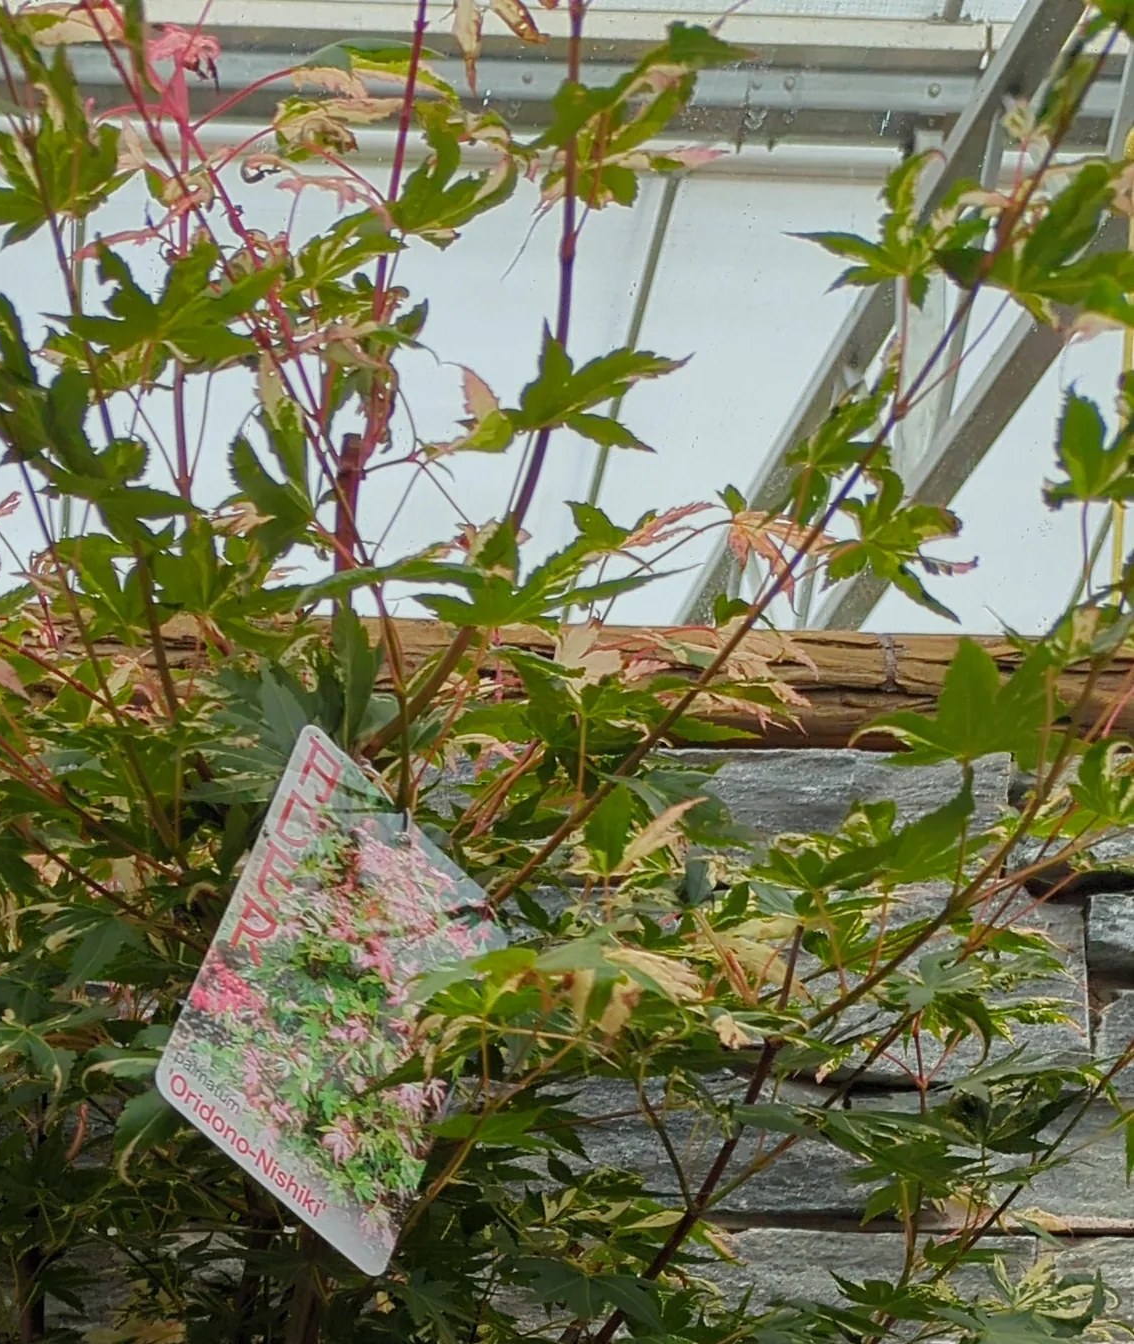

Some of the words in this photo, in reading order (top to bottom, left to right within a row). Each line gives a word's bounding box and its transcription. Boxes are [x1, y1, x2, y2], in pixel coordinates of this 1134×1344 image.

[229, 735, 342, 967] ACER
[168, 1067, 328, 1217] 'Oridono-Nishiki'
[173, 1051, 241, 1115] palmatum
